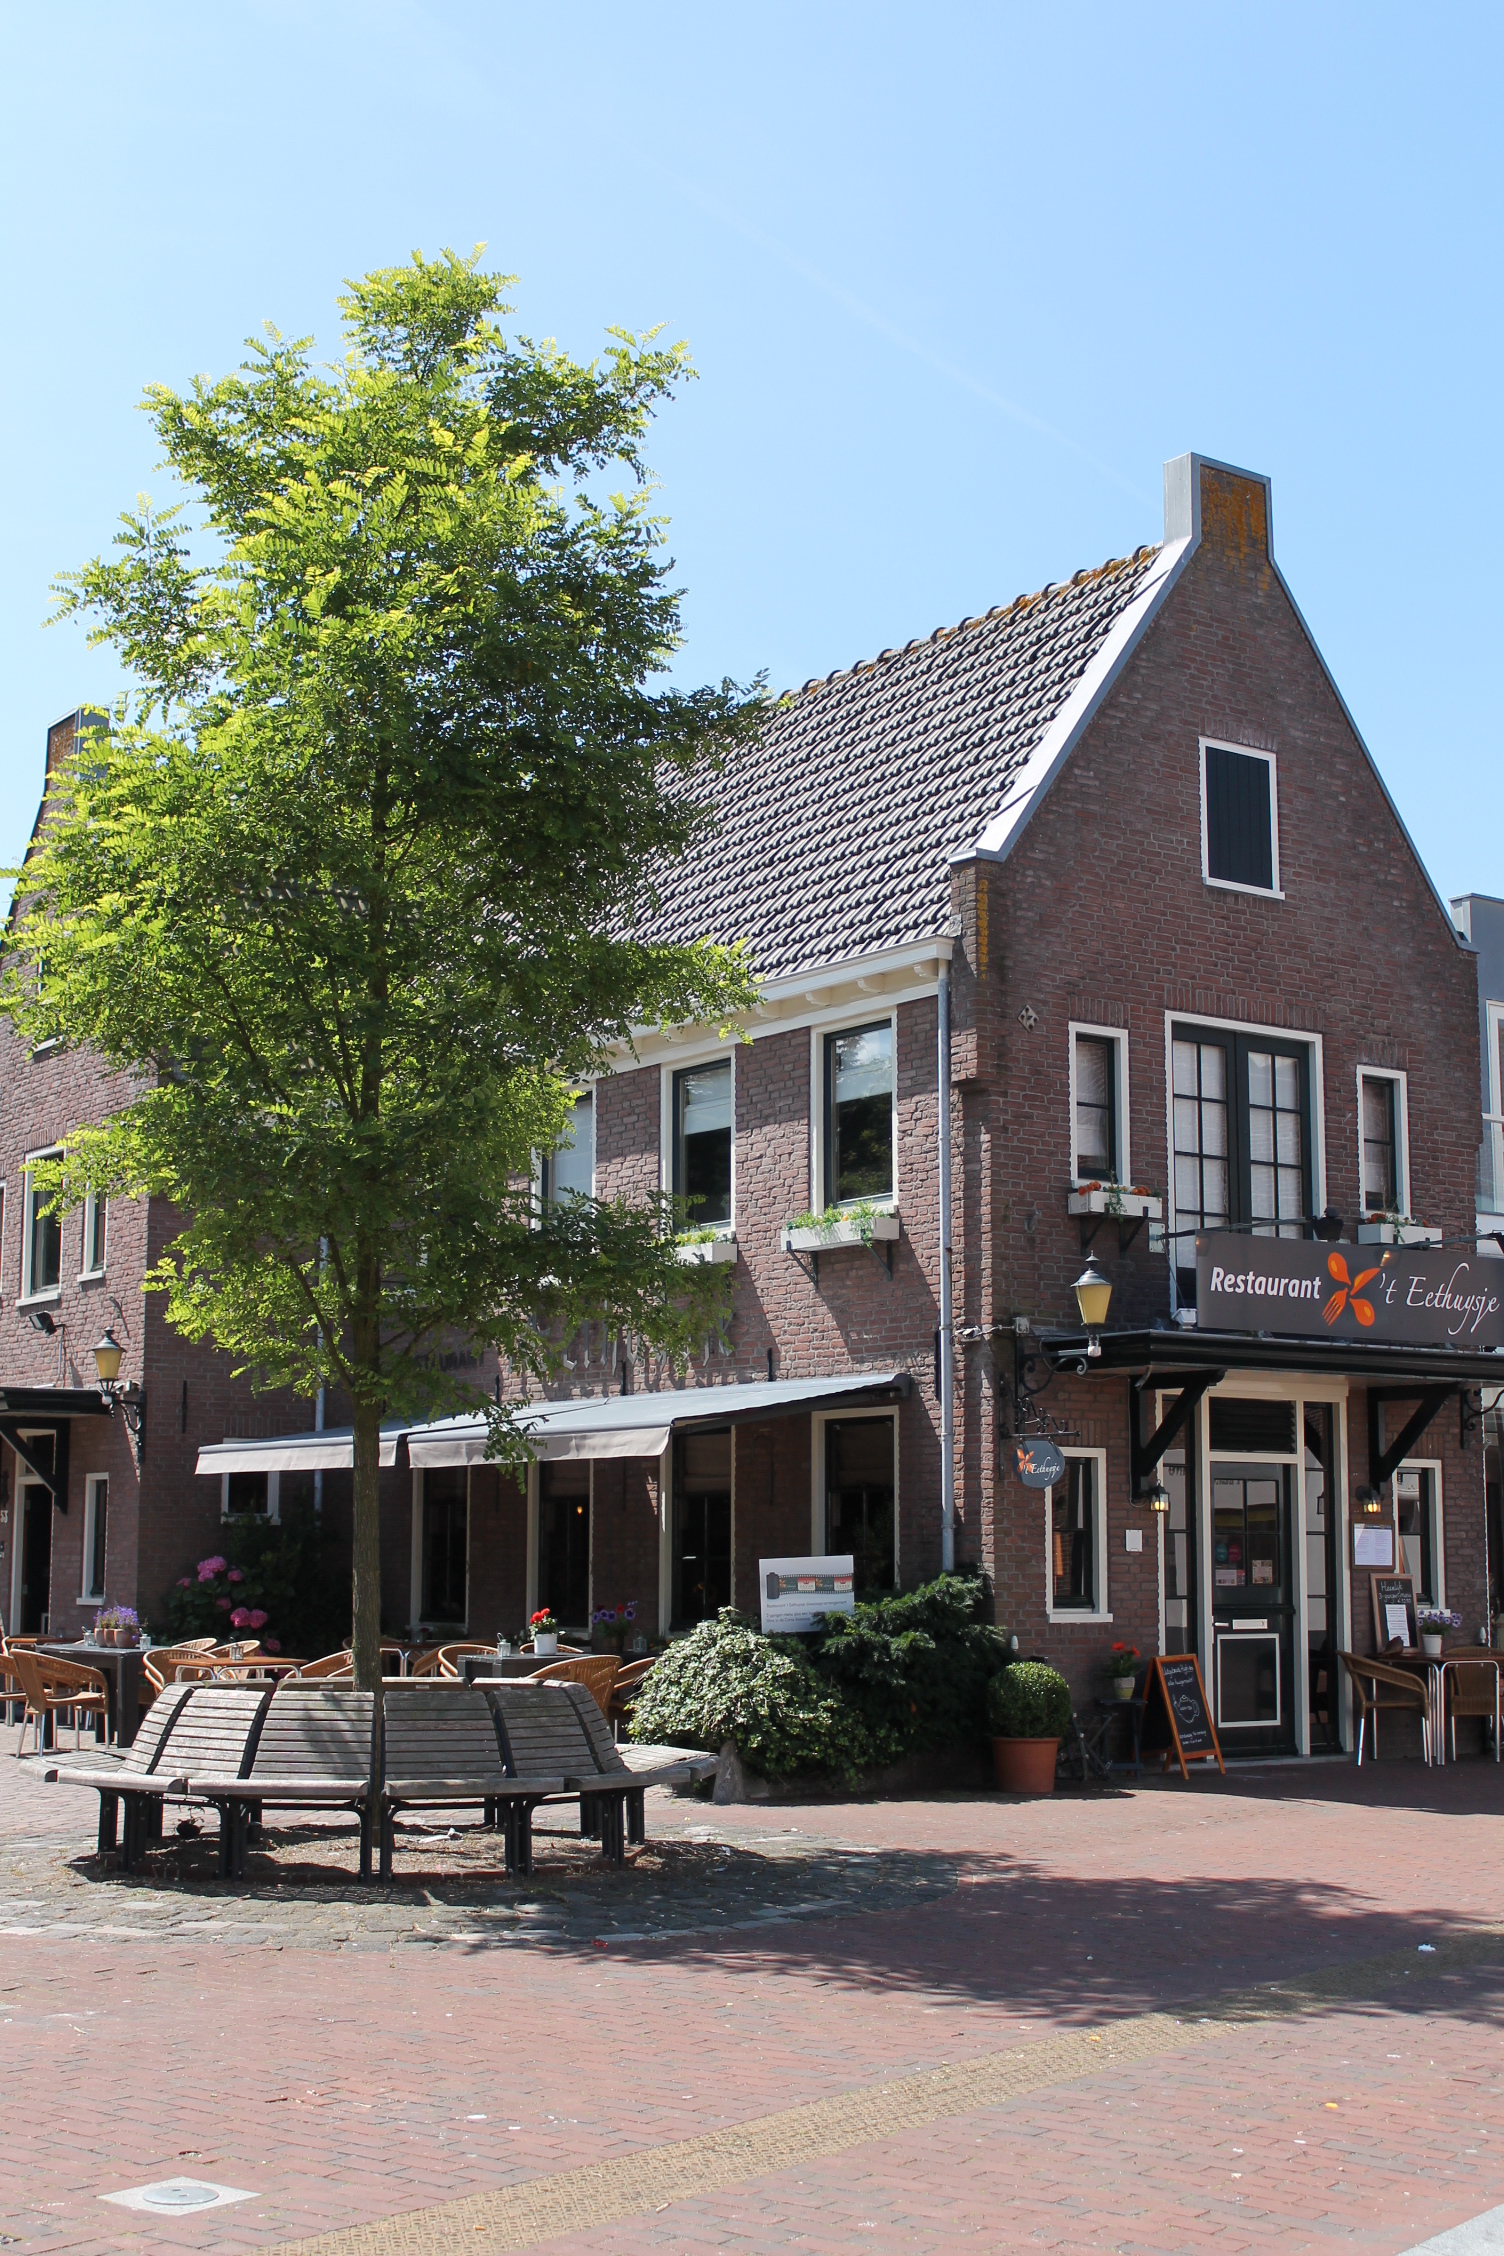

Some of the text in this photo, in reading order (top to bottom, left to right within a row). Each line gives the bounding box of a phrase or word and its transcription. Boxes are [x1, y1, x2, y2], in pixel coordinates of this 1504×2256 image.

[1210, 1262, 1500, 1336] Restaurant 't Eethuysje
